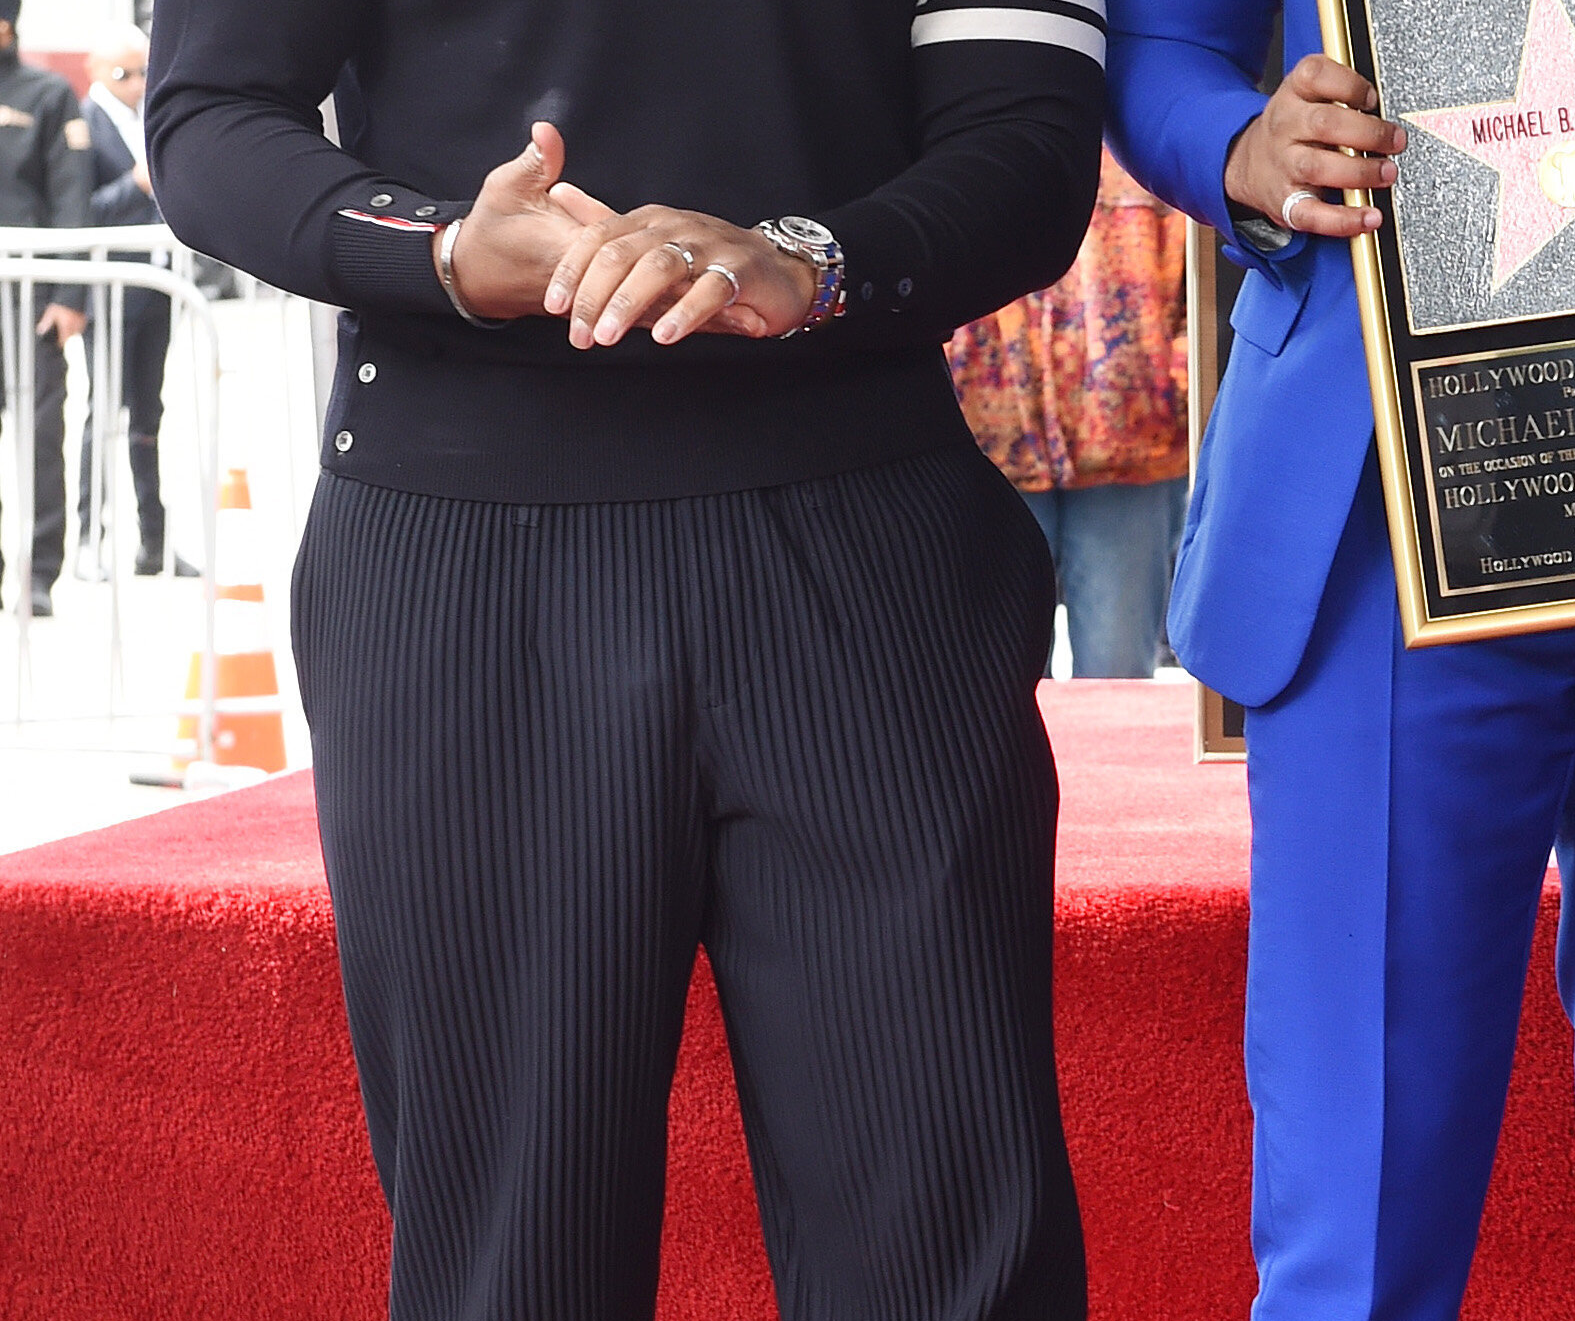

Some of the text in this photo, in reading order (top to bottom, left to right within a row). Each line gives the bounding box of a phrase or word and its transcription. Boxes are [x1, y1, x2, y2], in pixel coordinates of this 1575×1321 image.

[1471, 110, 1551, 145] MICHAEL
[1557, 106, 1575, 134] B.
[1428, 358, 1574, 399] HOLLYWOOD
[1437, 464, 1455, 479] ON
[1458, 461, 1482, 476] THE
[1483, 453, 1537, 473] OCCASION
[1539, 451, 1555, 464] OF
